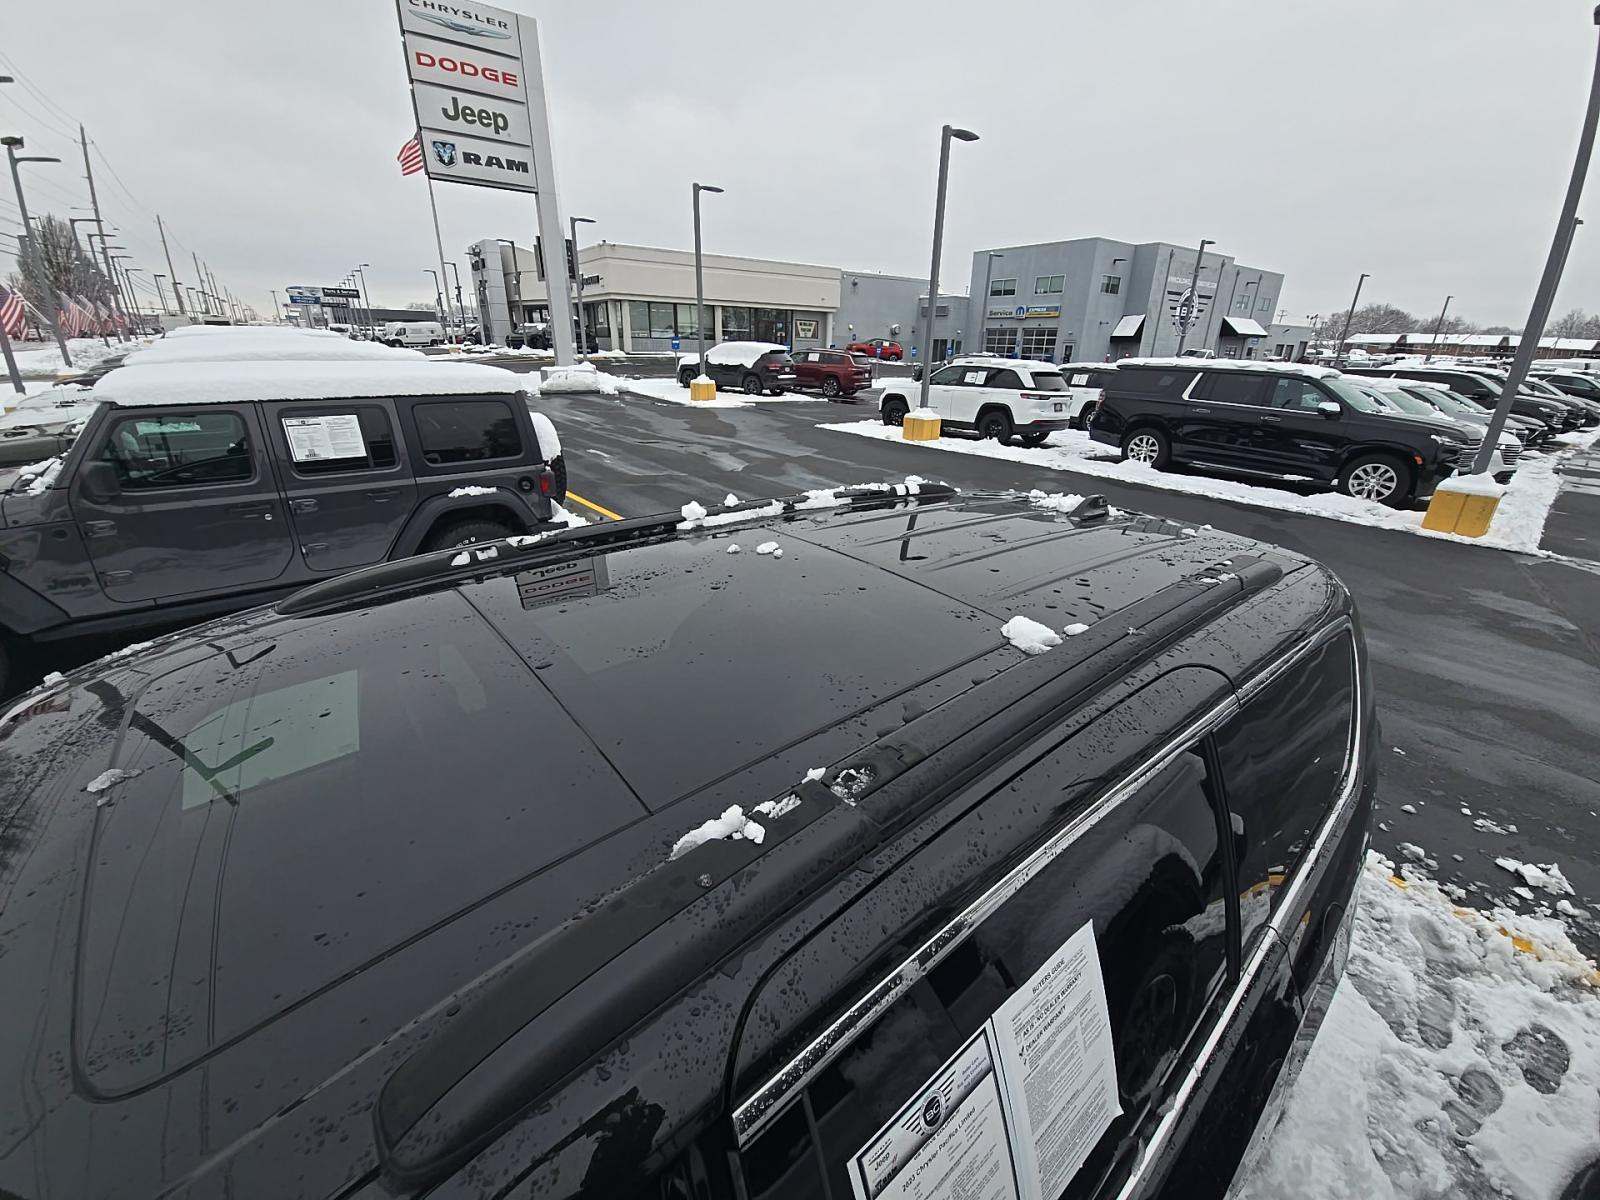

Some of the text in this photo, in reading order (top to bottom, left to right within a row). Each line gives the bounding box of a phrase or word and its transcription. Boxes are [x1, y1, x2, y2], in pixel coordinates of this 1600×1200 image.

[409, 0, 508, 29] CHRYSLER
[415, 52, 518, 87] DODGE
[441, 97, 509, 134] Jeep
[462, 152, 529, 173] RAM
[1032, 971, 1051, 994] BUYERS
[916, 1149, 939, 1176] Chrysler
[938, 1128, 959, 1152] Pacifica
[958, 1106, 976, 1129] Limited
